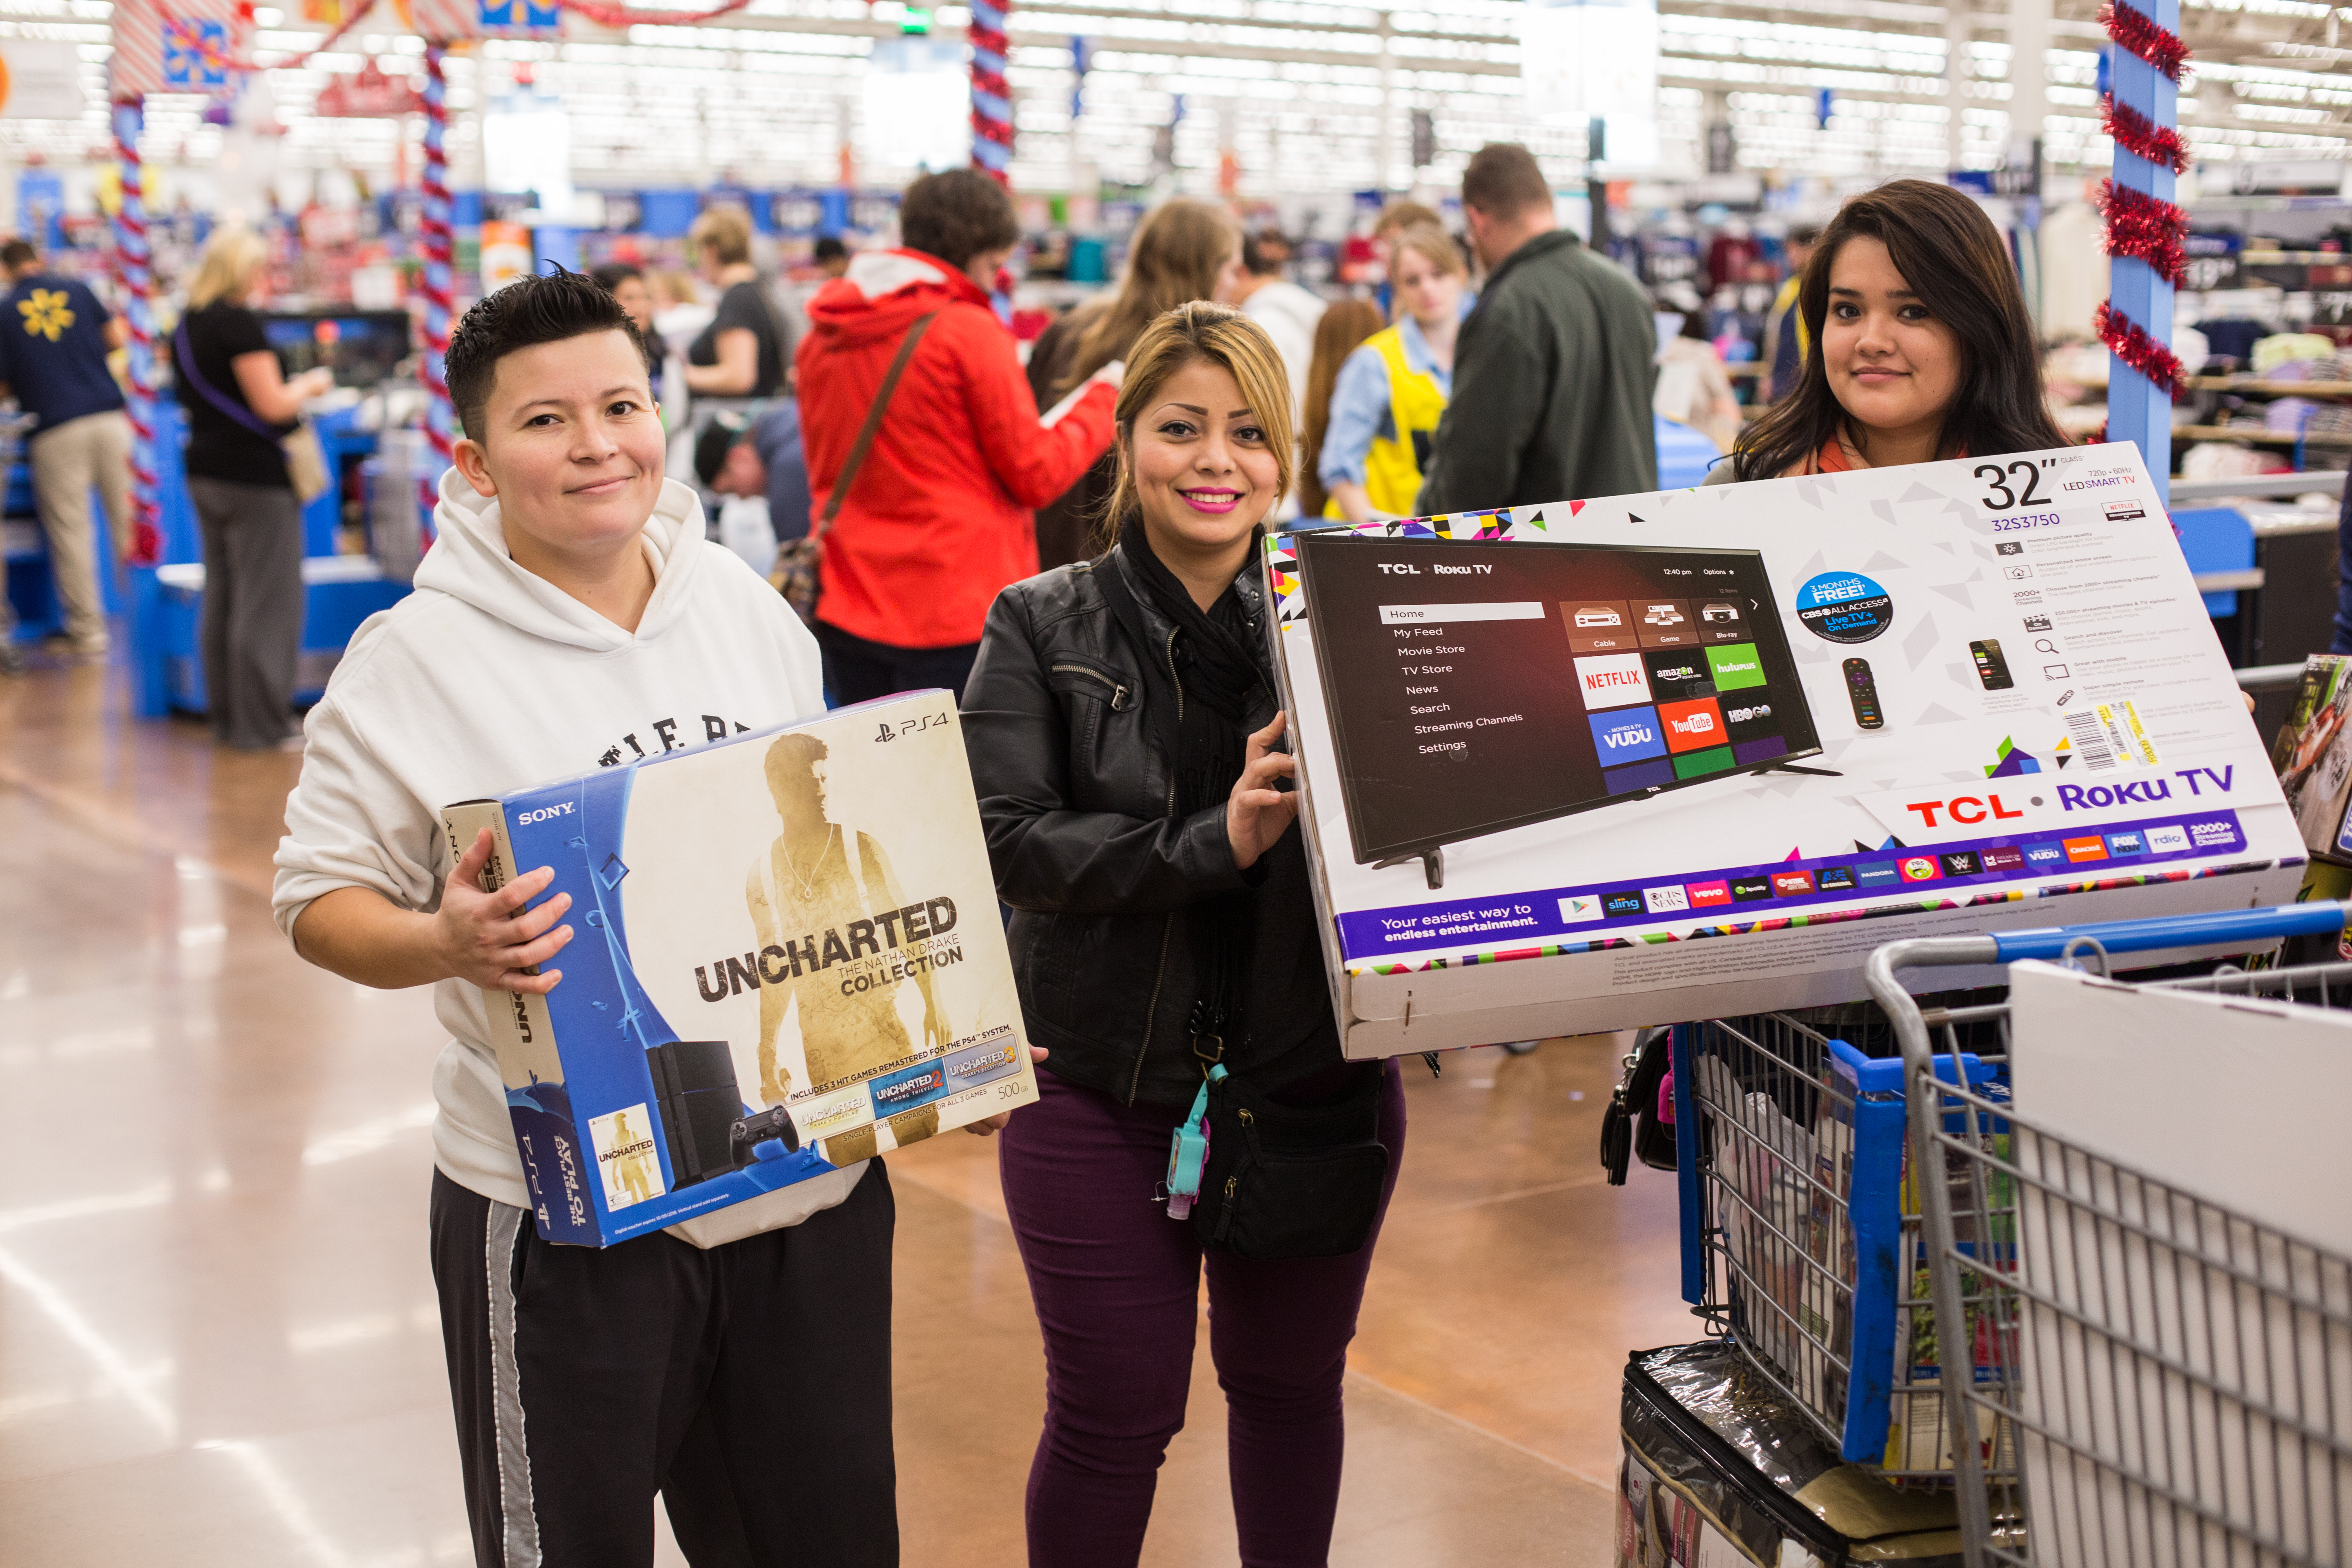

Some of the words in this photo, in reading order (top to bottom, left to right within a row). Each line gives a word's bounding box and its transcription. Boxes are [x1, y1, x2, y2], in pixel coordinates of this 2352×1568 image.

[1991, 513, 2060, 532] 32S3750
[1378, 564, 1421, 574] TCL
[1433, 564, 1471, 574] Roku
[1473, 565, 1492, 574] TV
[1818, 578, 1861, 590] MONTHS
[1801, 610, 1823, 619] CBS
[1831, 606, 1847, 614] ALL
[1849, 599, 1884, 611] ACCESS
[1824, 616, 1849, 626] Live
[1842, 618, 1877, 629] Demand
[1394, 629, 1410, 638] My
[1414, 628, 1443, 637] Feed
[1398, 647, 1432, 656] Movie
[1435, 645, 1465, 654] Store
[1402, 667, 1418, 675] TV
[1422, 665, 1452, 674] Store
[1586, 670, 1641, 690] NETFLIX
[1406, 686, 1439, 695] News
[1410, 703, 1450, 714] Search
[900, 712, 949, 735] PS4
[1414, 721, 1473, 734] Streaming
[1476, 714, 1523, 726] Channels
[1672, 716, 1711, 733] YouTube
[1604, 728, 1653, 748] VUDU
[1419, 741, 1466, 754] Settings
[1907, 793, 2023, 828] TCL
[2057, 778, 2172, 811] Roku
[2175, 764, 2233, 795] TV
[518, 802, 574, 826] SONY
[2190, 822, 2232, 834] 2000+
[2194, 831, 2234, 841] Streaming
[2111, 835, 2140, 847] FOX
[2116, 844, 2140, 853] NOW
[2154, 835, 2180, 845] rdio
[2196, 836, 2236, 846] Channels
[2029, 849, 2060, 860] VUDU
[1861, 870, 1895, 878] PANDORA
[1659, 890, 1681, 899] CBS
[1694, 888, 1724, 898] vevo
[1609, 900, 1639, 911] sling
[1652, 898, 1684, 908] NEWS
[1381, 916, 1417, 930] Your
[1422, 910, 1475, 925] easiest
[1479, 906, 1510, 922] way
[1514, 904, 1531, 914] to
[1385, 928, 1436, 942] endless
[1439, 916, 1538, 936] entertainment.
[694, 896, 958, 1002] UNCHARTED
[837, 964, 862, 978] THE
[865, 949, 915, 971] NATHAN
[919, 933, 960, 953] DRAKE
[841, 946, 964, 996] COLLECTION
[790, 1084, 829, 1101] INCLUDES
[836, 1076, 849, 1086] HIT
[851, 1068, 878, 1081] GAMES
[879, 1051, 928, 1072] REMASTERED
[930, 1045, 945, 1056] FOR
[946, 1040, 961, 1050] THE
[982, 1024, 1011, 1039] SYSTEM.
[949, 1051, 1005, 1076] UNCHARTED
[1004, 1046, 1016, 1063] 3
[962, 1069, 980, 1079] DRAKE'S
[981, 1062, 1006, 1073] DECEPTION
[876, 1074, 932, 1100] UNCHARTED
[931, 1070, 944, 1088] 2
[890, 1093, 910, 1102] AMONG
[912, 1085, 933, 1095] THIEVES
[998, 1082, 1020, 1100] 500
[801, 1096, 866, 1126] UNCHARTED
[834, 1109, 859, 1122] FORTUNE
[843, 1120, 893, 1141] SINGLE-PLAYER
[894, 1107, 932, 1124] CAMPAIGNS
[933, 1102, 946, 1111] FOR
[947, 1098, 959, 1107] ALL
[965, 1089, 987, 1100] GAMES
[554, 1136, 567, 1171] PLACE
[599, 1140, 653, 1162] UNCHARTED
[628, 1149, 654, 1160] COLLECTION
[522, 1134, 543, 1194] PS4
[559, 1136, 579, 1189] PLAY
[563, 1174, 573, 1201] BEST
[569, 1204, 577, 1226] THE
[574, 1196, 586, 1227] TO
